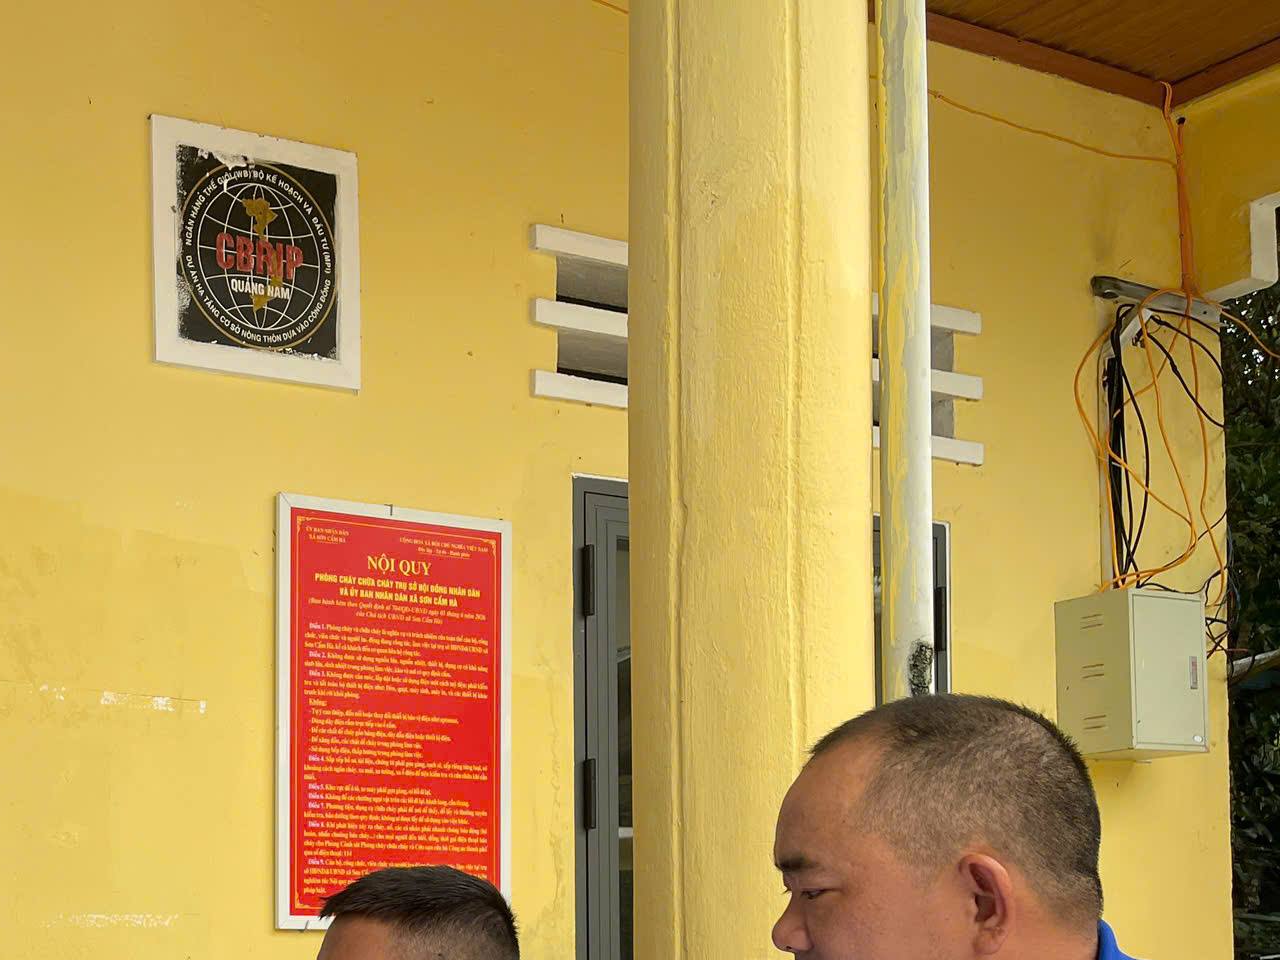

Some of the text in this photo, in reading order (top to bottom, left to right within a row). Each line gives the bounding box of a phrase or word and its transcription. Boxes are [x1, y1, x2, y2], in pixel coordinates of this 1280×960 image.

[215, 232, 304, 280] CBRIP
[267, 285, 290, 300] NAM
[367, 553, 432, 576] NỘI QUY
